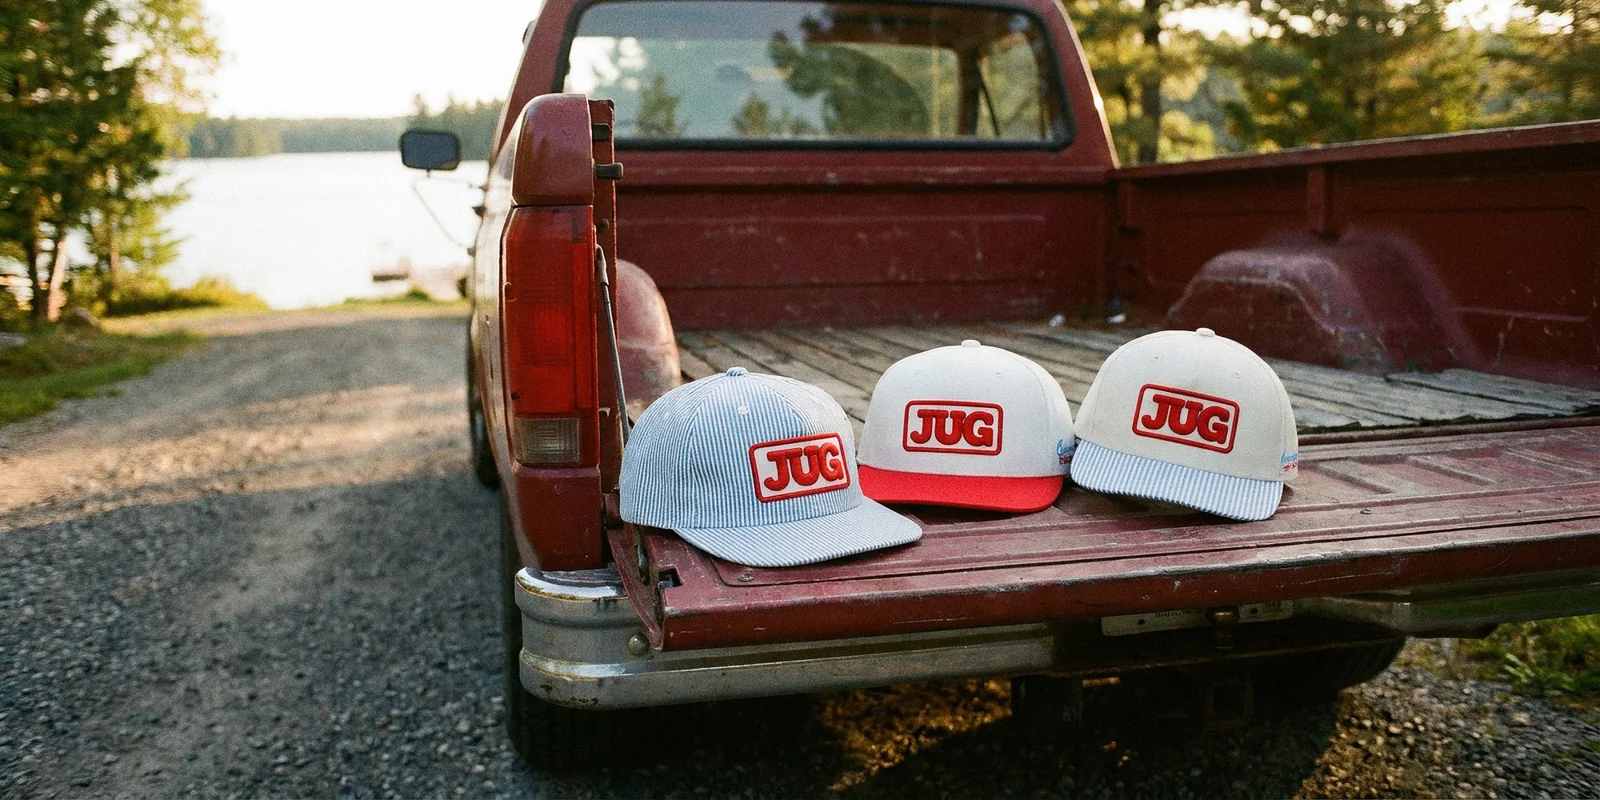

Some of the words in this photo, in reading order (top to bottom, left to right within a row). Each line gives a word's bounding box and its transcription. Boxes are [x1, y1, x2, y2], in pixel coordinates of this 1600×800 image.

[910, 409, 994, 447] JUG
[1141, 394, 1230, 444] JUG
[764, 442, 844, 491] JUG
